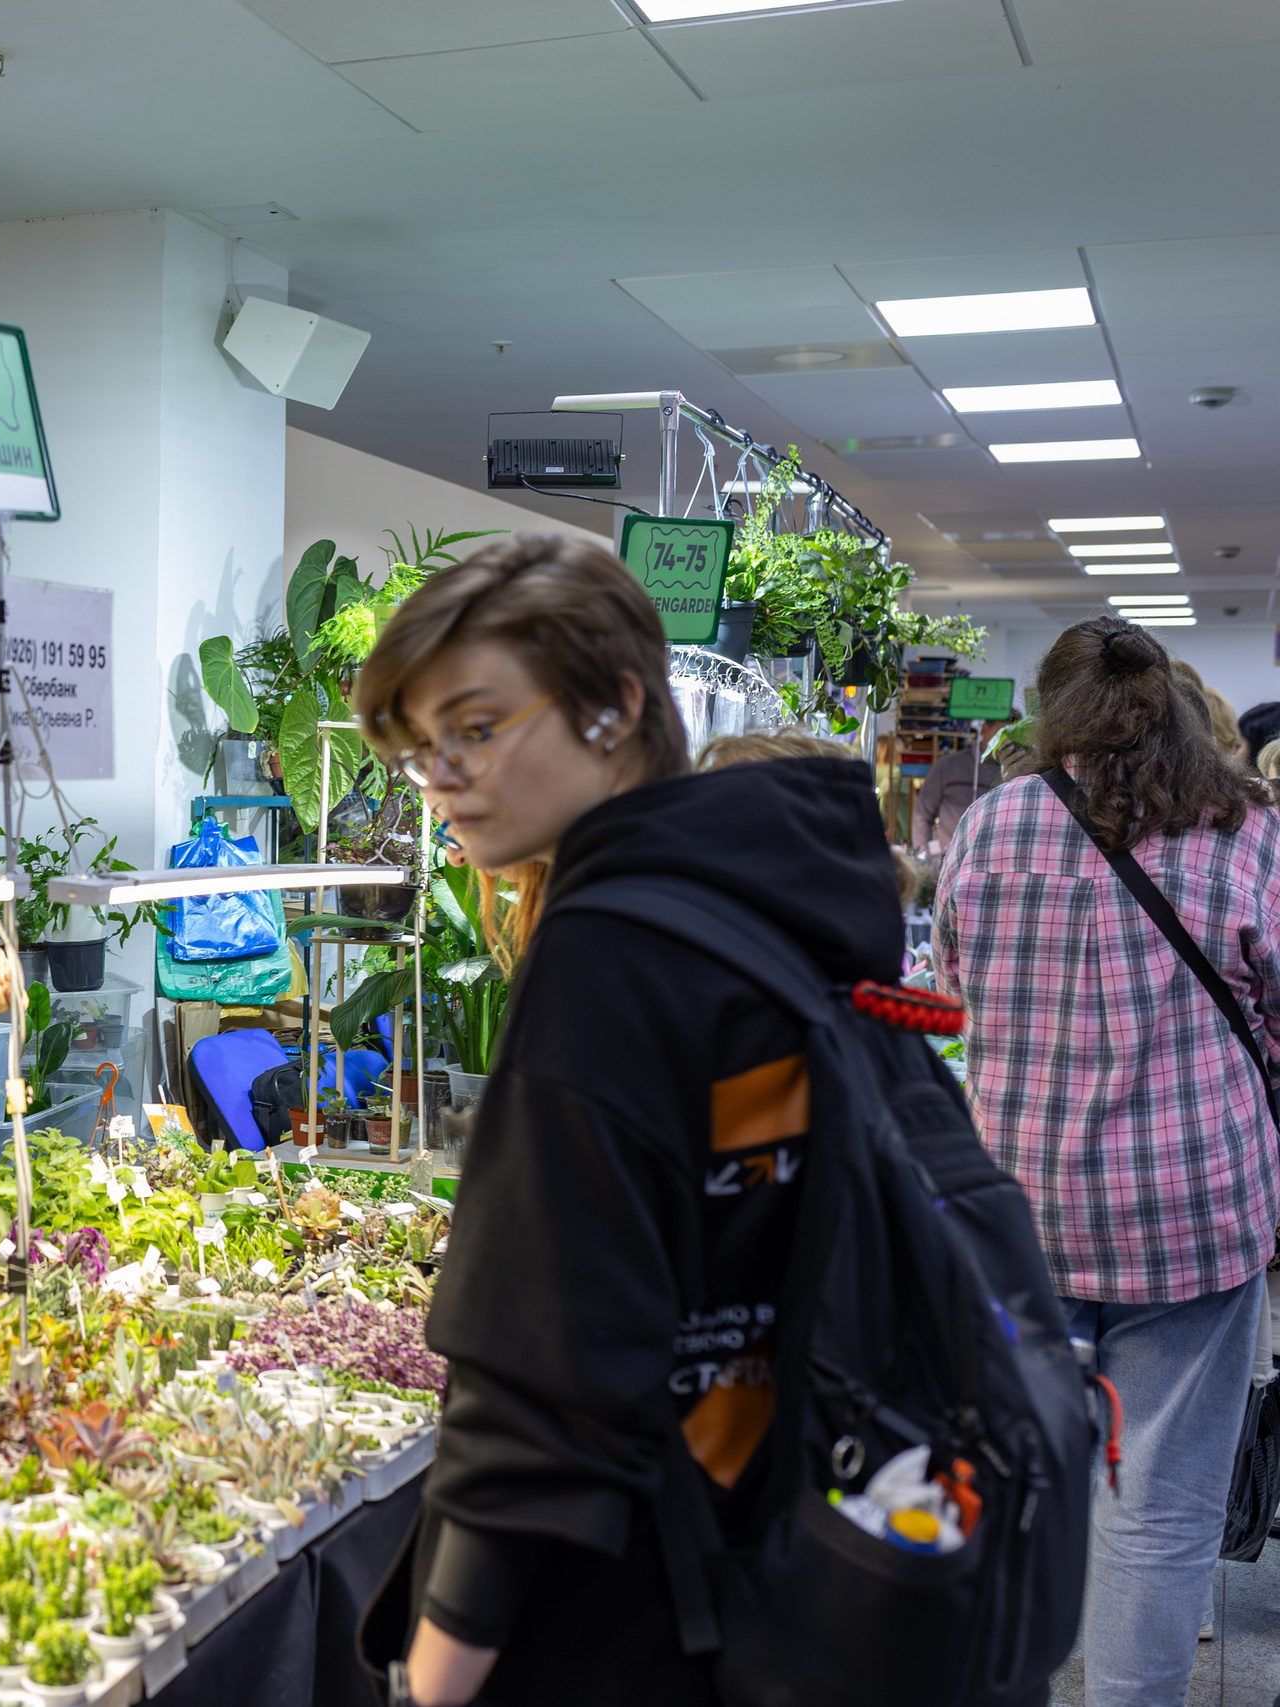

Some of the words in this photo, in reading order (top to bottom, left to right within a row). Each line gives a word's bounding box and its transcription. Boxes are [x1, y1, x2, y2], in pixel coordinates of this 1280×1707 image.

[653, 542, 708, 572] 74-75
[41, 640, 63, 667] 191
[68, 643, 85, 668] 59
[89, 645, 106, 669] 95
[22, 675, 78, 700] Сбербанк
